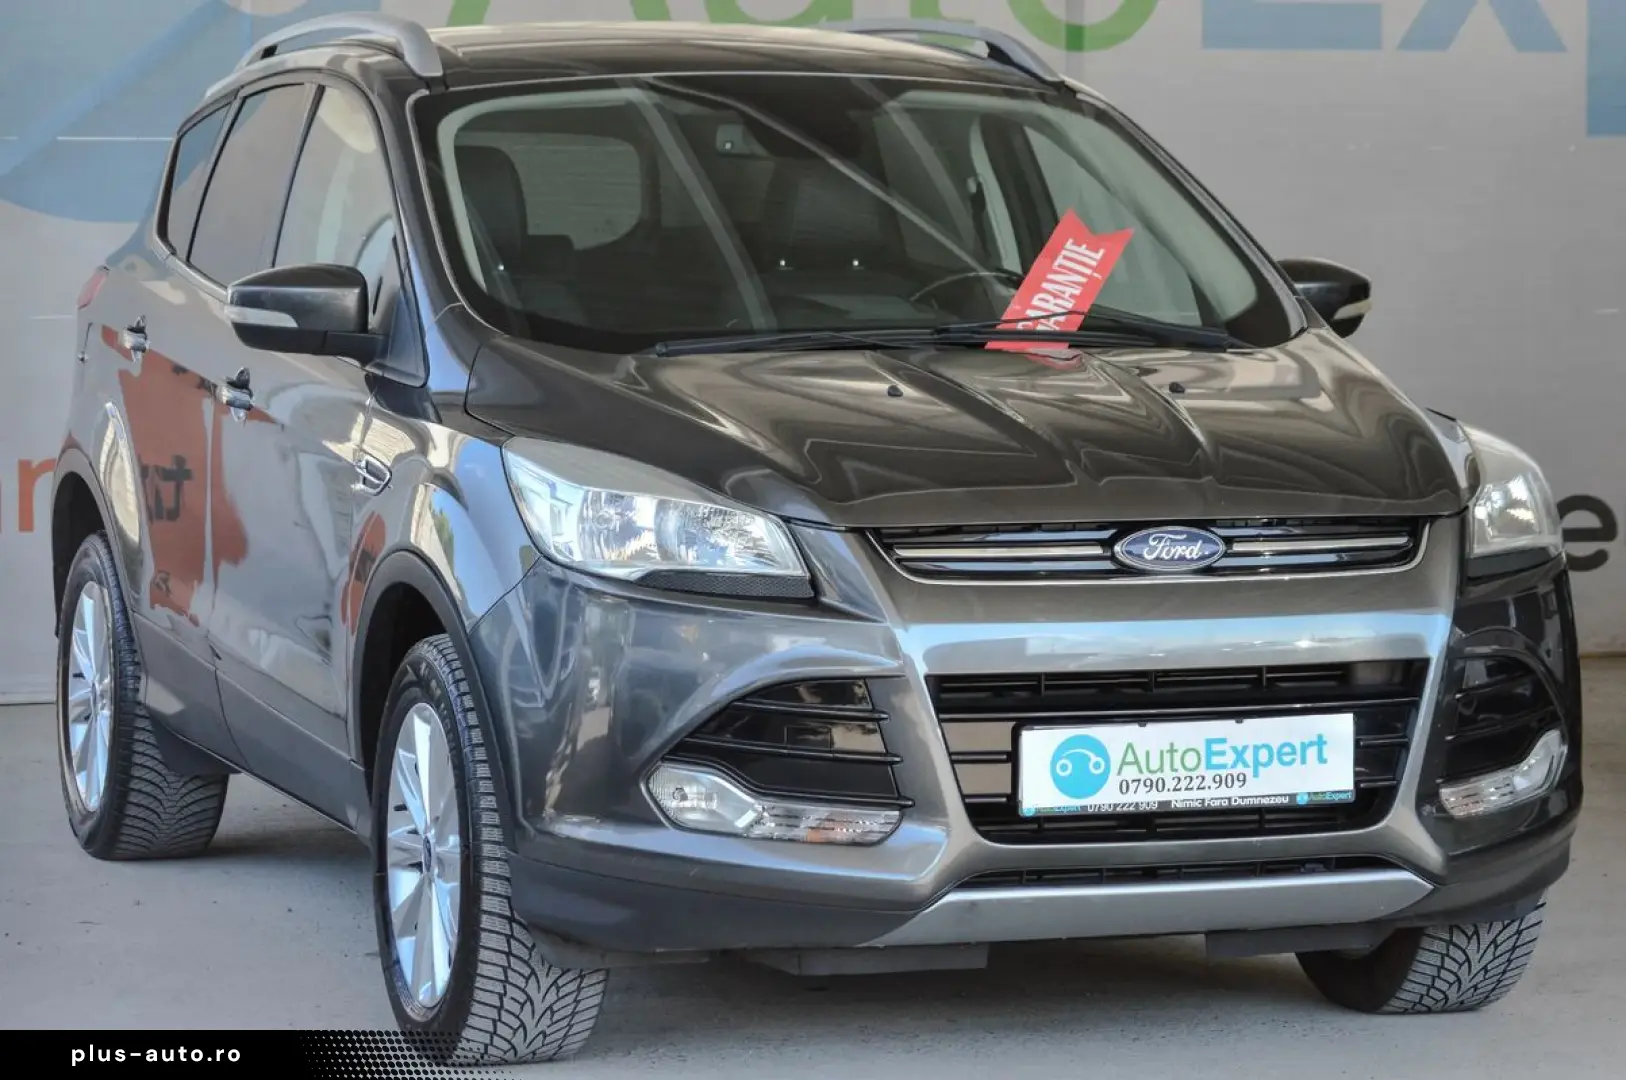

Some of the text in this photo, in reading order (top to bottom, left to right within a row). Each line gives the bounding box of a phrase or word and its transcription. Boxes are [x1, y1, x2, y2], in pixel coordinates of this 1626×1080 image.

[1143, 533, 1203, 561] Ford
[1116, 733, 1329, 779] AutoExpert
[1119, 772, 1247, 796] 0790.222.909
[1171, 798, 1202, 809] Nimic
[1205, 797, 1229, 808] Fara
[1231, 794, 1290, 806] Dumnezeu
